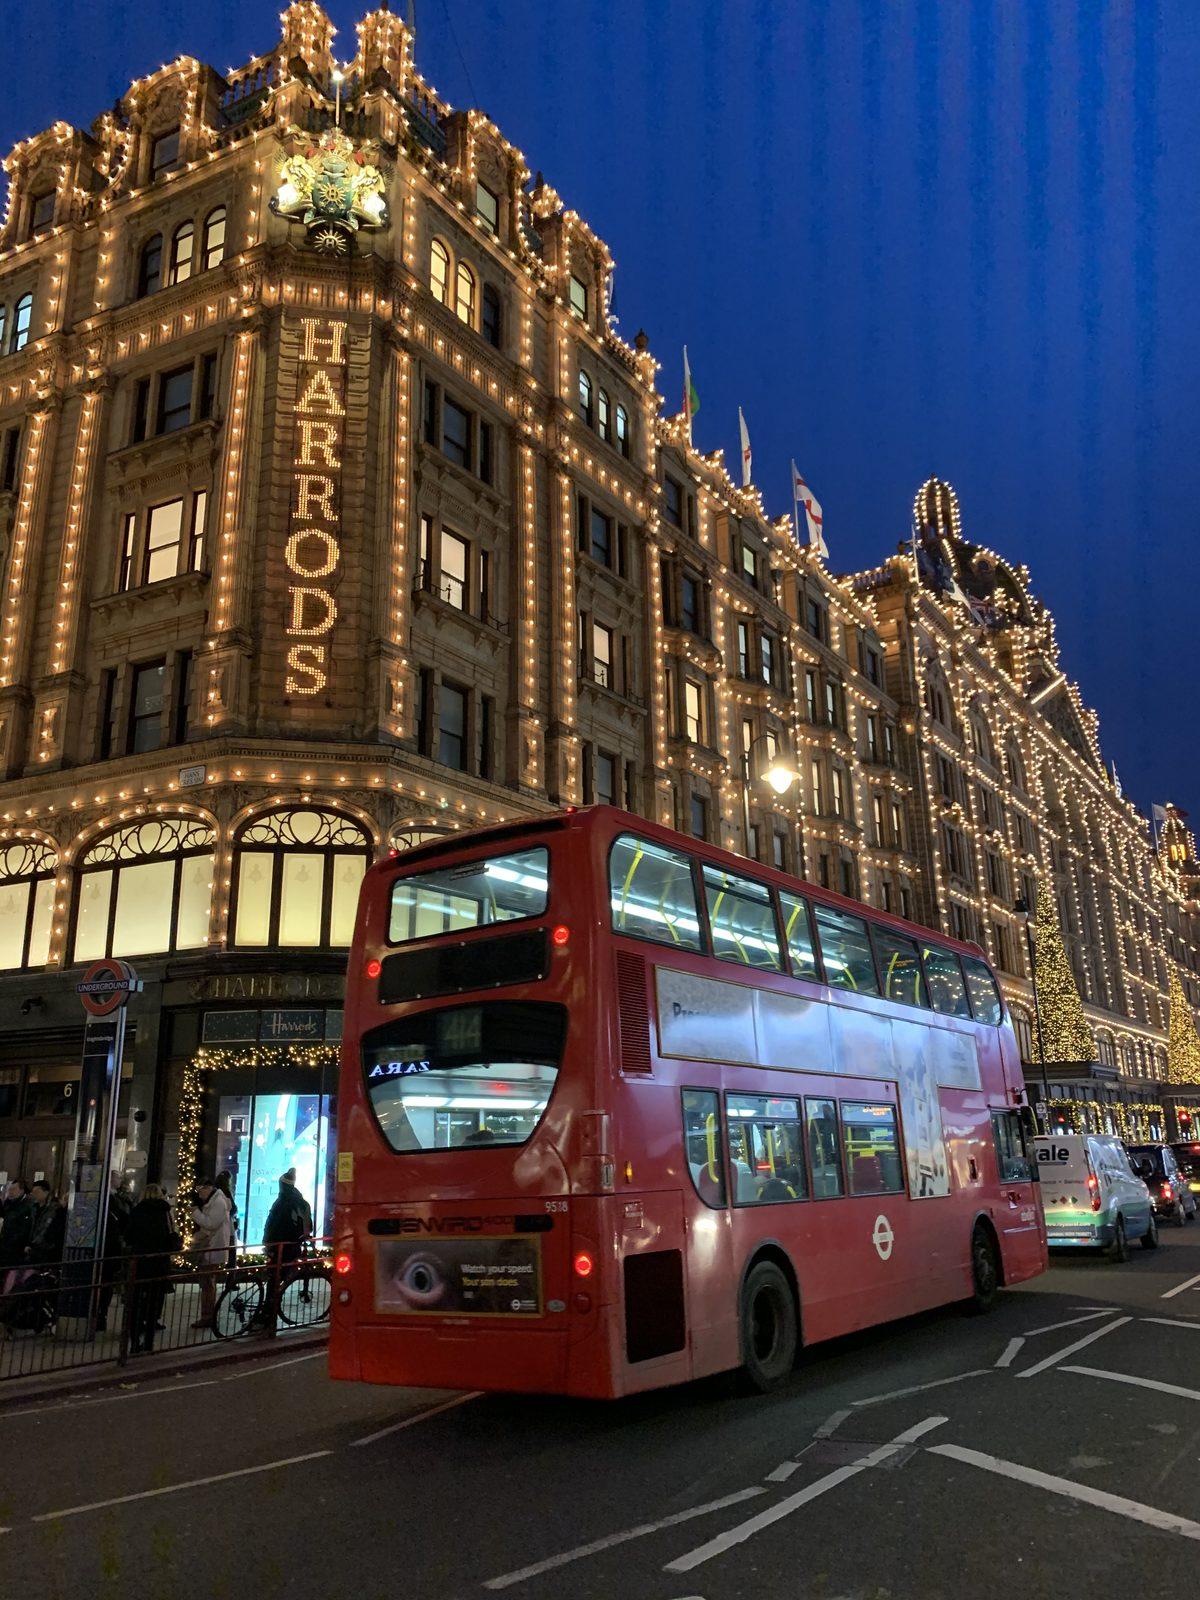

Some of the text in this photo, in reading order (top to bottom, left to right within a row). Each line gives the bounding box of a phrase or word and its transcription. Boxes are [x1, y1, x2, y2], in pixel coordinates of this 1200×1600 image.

[285, 318, 347, 695] HARRODS
[78, 981, 128, 992] UNDERGROUND
[212, 976, 337, 998] HARROD
[267, 1013, 318, 1035] Harrods
[63, 1083, 73, 1098] 6
[1036, 1144, 1070, 1161] ale
